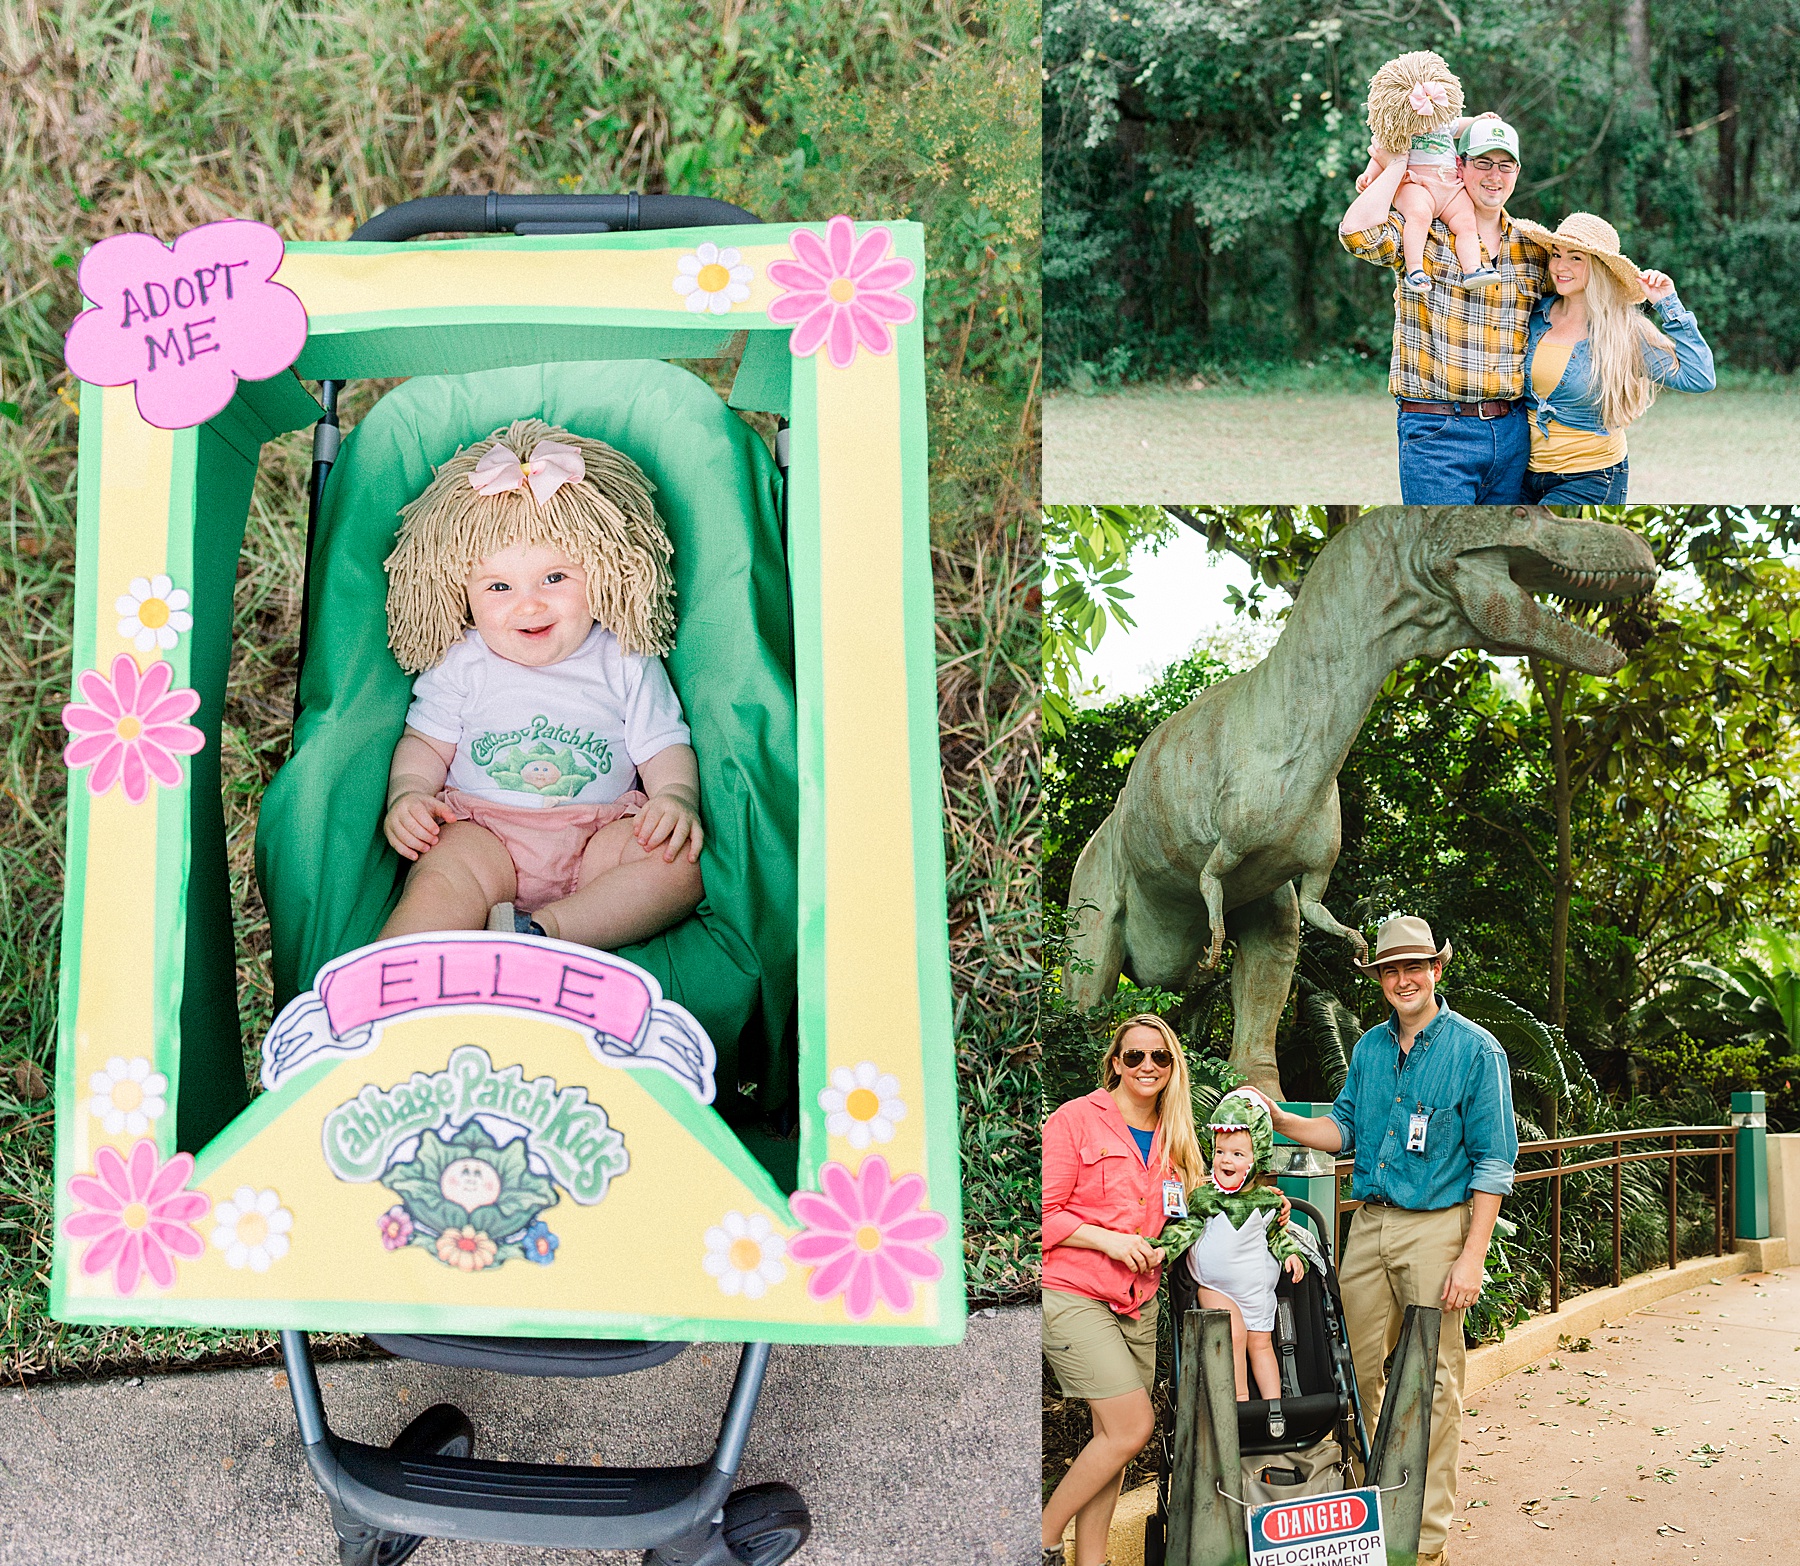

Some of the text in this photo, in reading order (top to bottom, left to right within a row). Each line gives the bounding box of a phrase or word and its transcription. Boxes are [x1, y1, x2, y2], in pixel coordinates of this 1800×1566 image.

[121, 260, 249, 328] ADOPT
[145, 316, 220, 371] ME
[531, 714, 580, 745] Patch
[573, 731, 613, 774] Kids
[379, 954, 605, 1020] ELLE
[326, 1052, 624, 1197] Cabbage Patch Kids
[1277, 1501, 1353, 1538] DANGER
[1254, 1535, 1381, 1566] VELOCIRAPTOR
